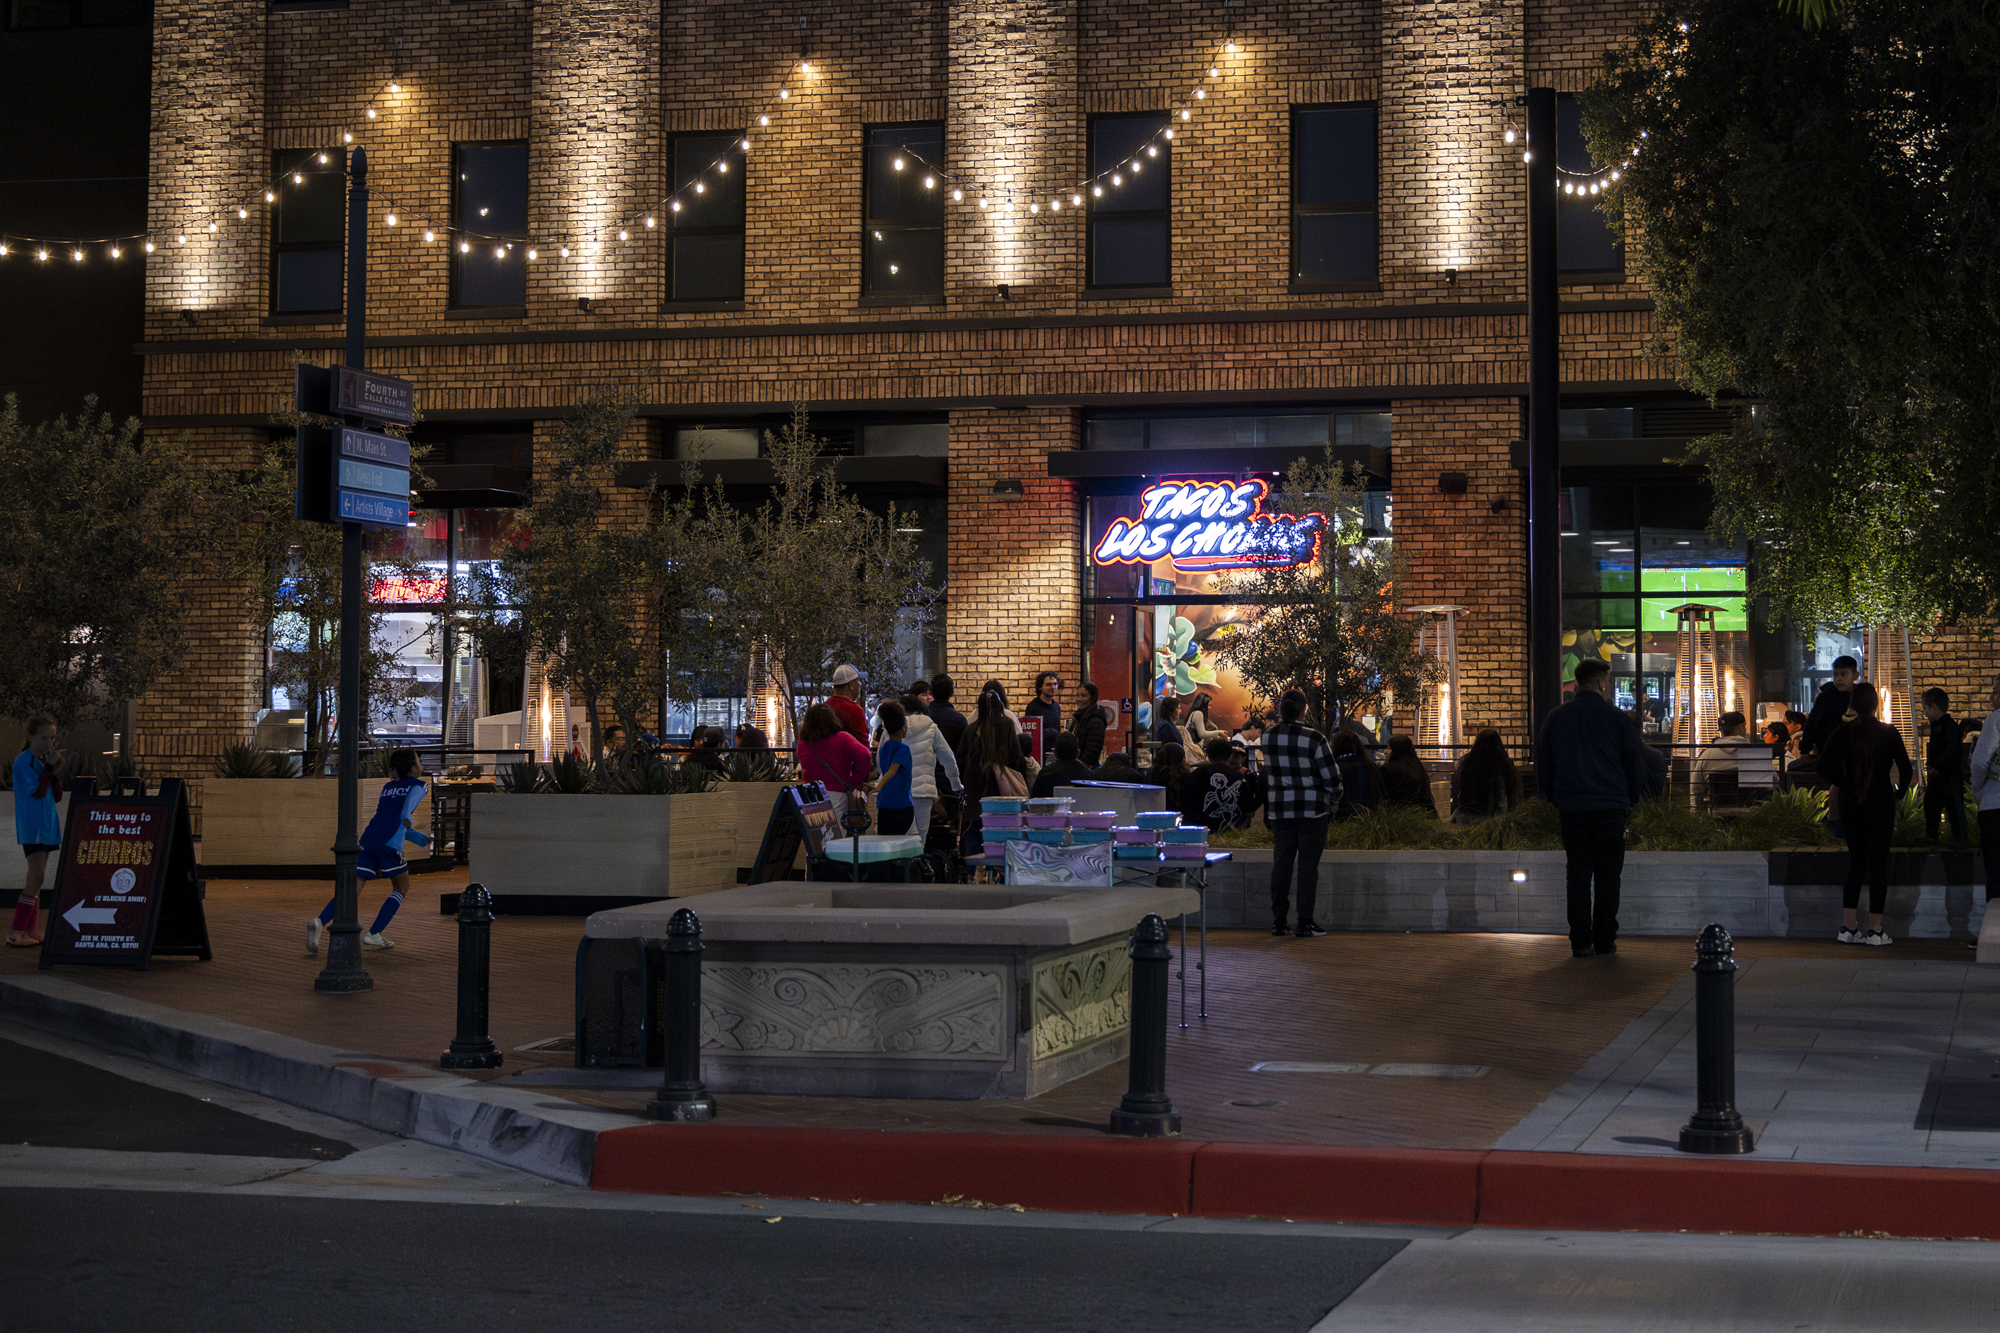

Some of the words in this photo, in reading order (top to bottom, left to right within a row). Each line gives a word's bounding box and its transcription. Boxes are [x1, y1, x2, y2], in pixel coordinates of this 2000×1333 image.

[365, 380, 398, 398] FOURTH
[364, 393, 382, 403] CALLE
[384, 397, 406, 408] CUATRO
[357, 438, 363, 450] N.
[365, 439, 379, 454] Main
[356, 469, 371, 483] West
[356, 499, 373, 515] Artists
[374, 502, 393, 520] Village
[1144, 483, 1254, 520] TACOS
[1098, 522, 1173, 558] LOS
[90, 811, 111, 821] This
[115, 814, 137, 823] way
[140, 812, 151, 822] to
[98, 824, 114, 834] the
[119, 825, 141, 835] best
[77, 840, 154, 866] CHURROS
